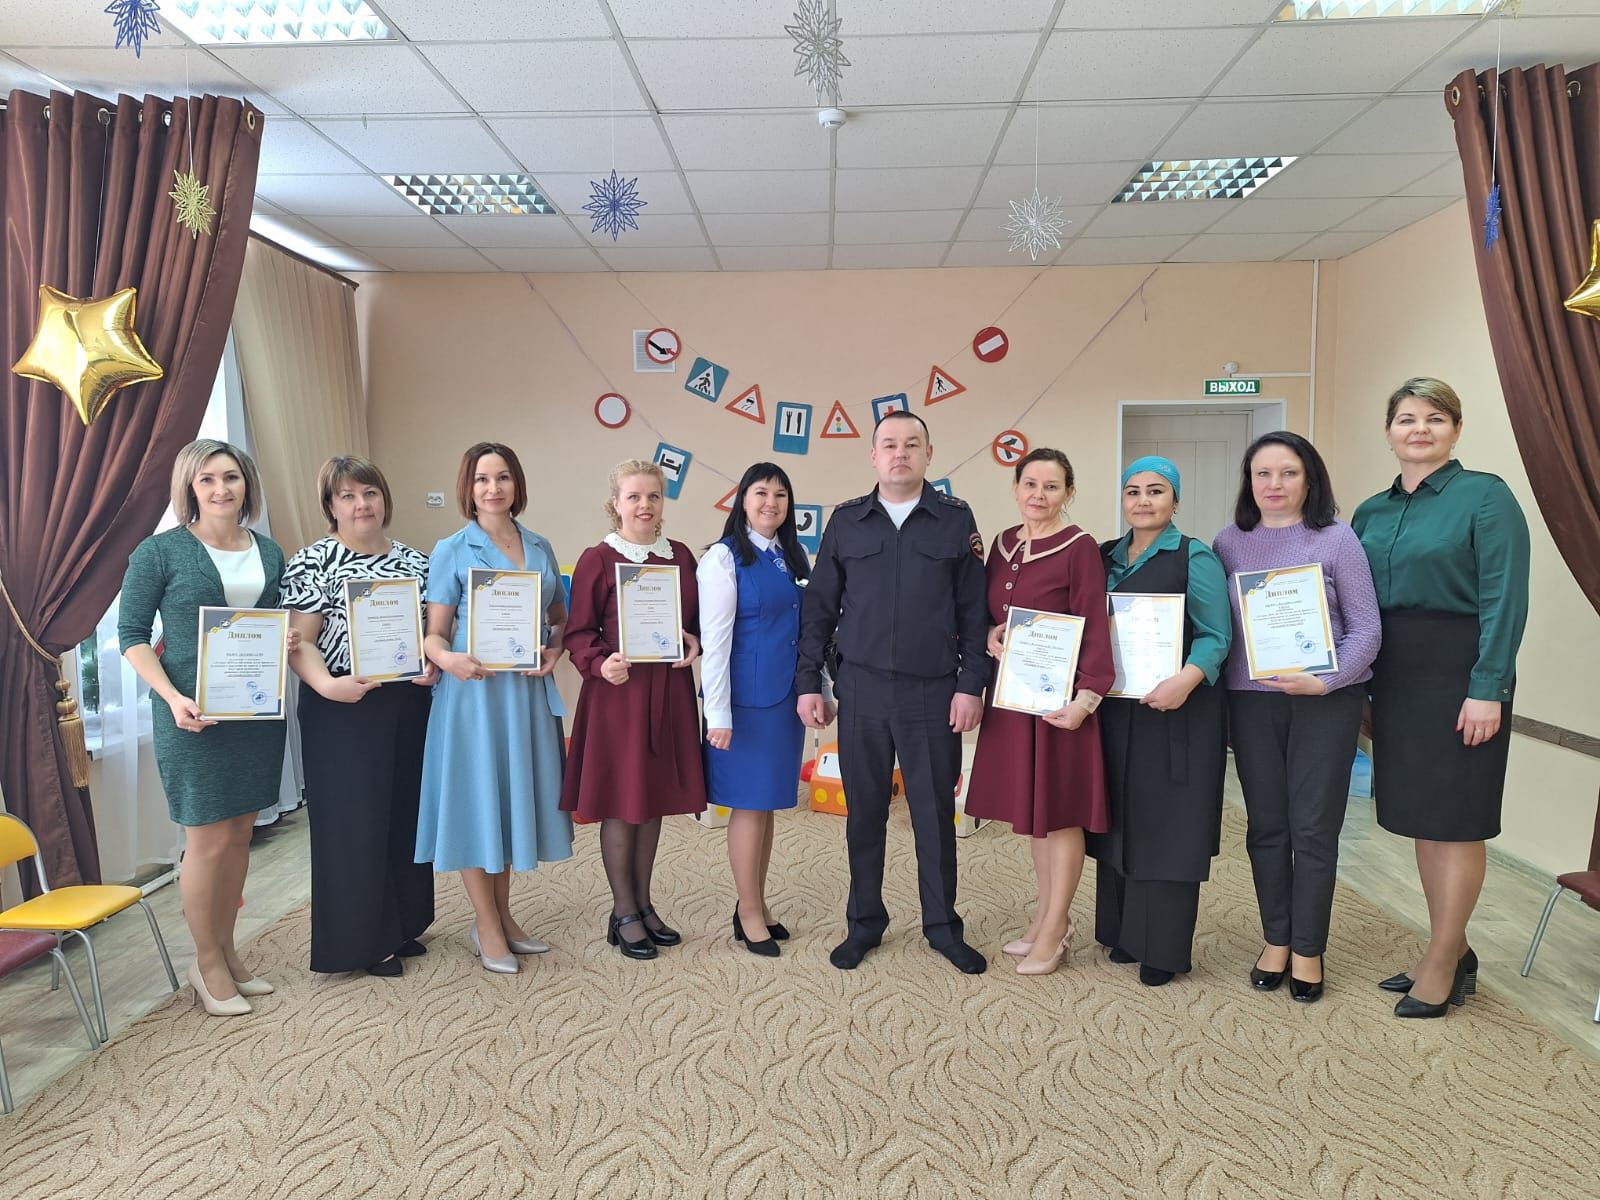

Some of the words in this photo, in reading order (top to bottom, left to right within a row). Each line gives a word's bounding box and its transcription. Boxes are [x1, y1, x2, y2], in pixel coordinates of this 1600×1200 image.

[1210, 382, 1256, 393] ВЫХОД
[228, 631, 262, 640] Диплом
[823, 755, 828, 765] 1
